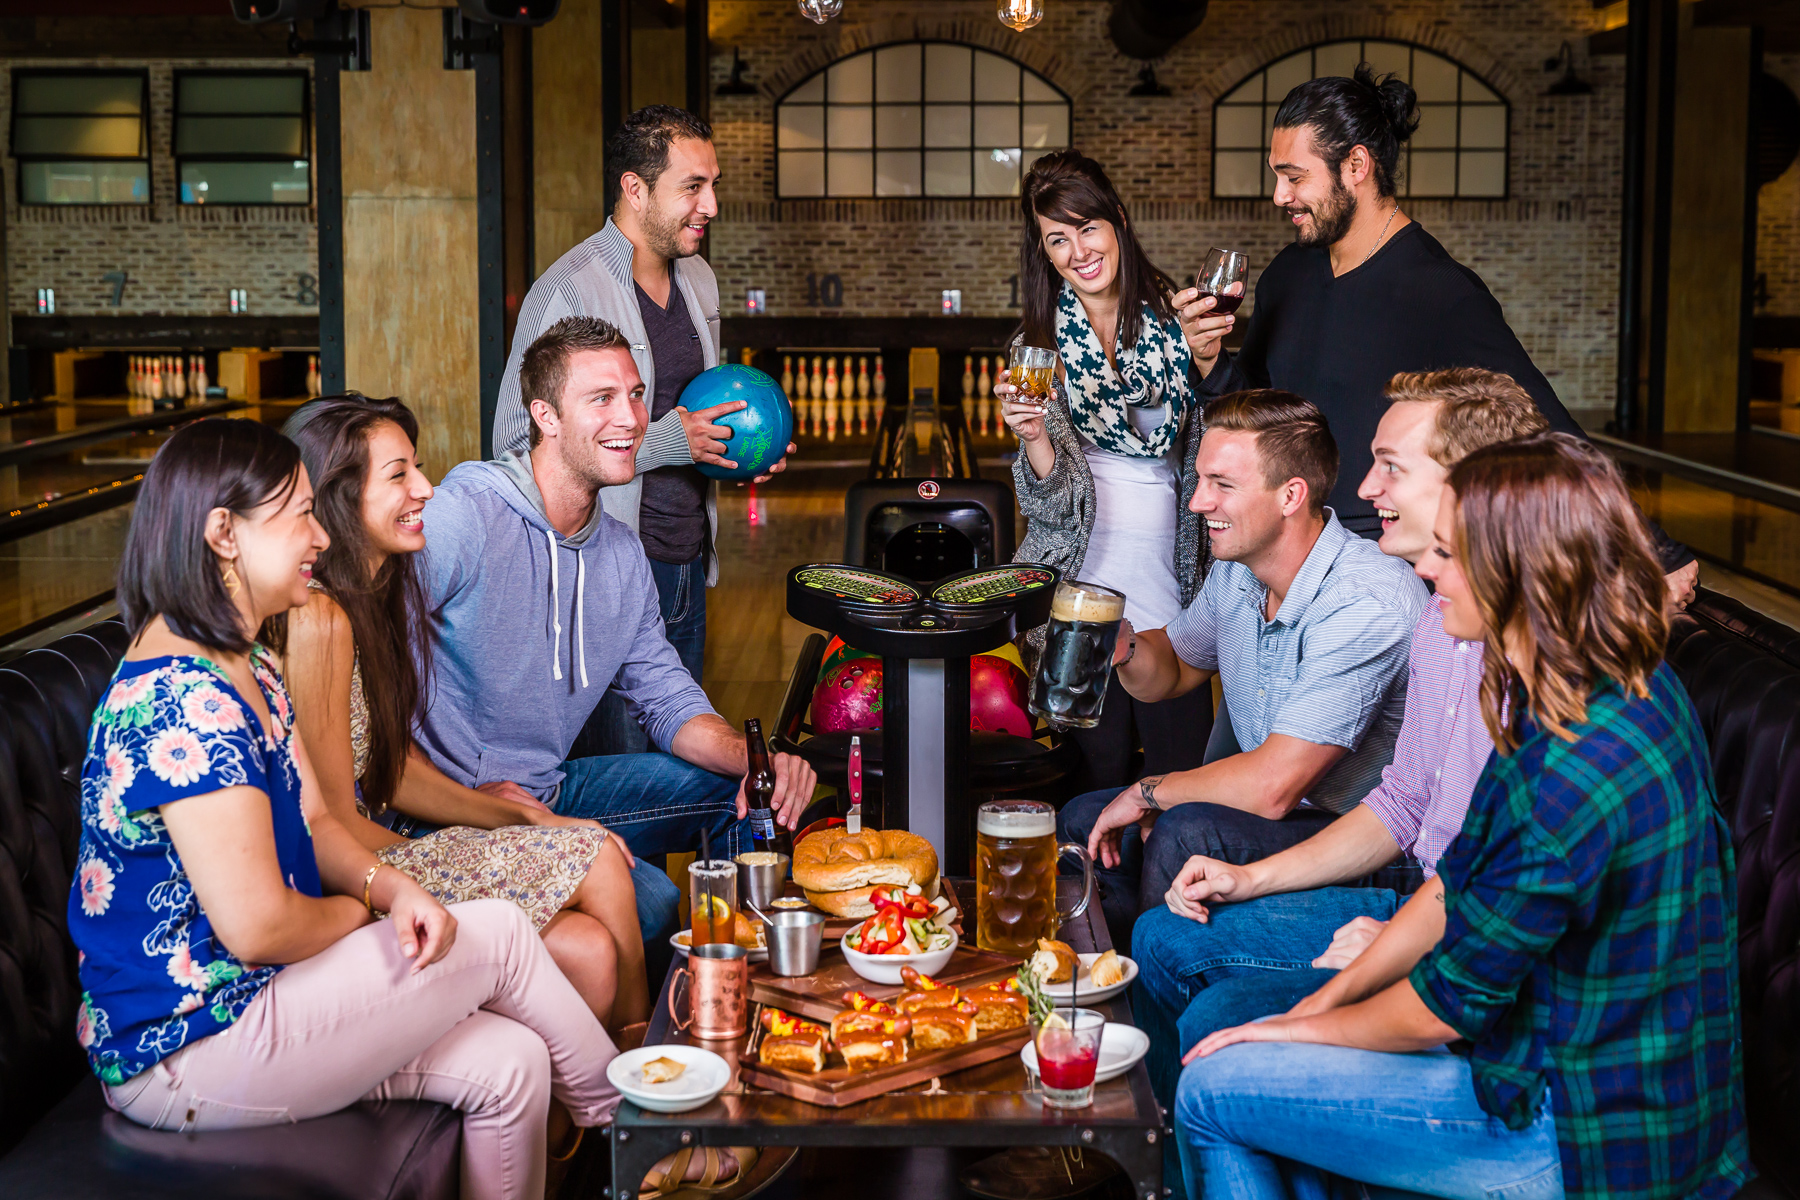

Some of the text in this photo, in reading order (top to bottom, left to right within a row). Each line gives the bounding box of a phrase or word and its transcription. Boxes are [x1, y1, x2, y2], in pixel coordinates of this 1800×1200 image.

[102, 271, 128, 307] 7
[297, 272, 319, 307] 8
[805, 272, 844, 308] 10
[738, 436, 751, 457] LARGE
